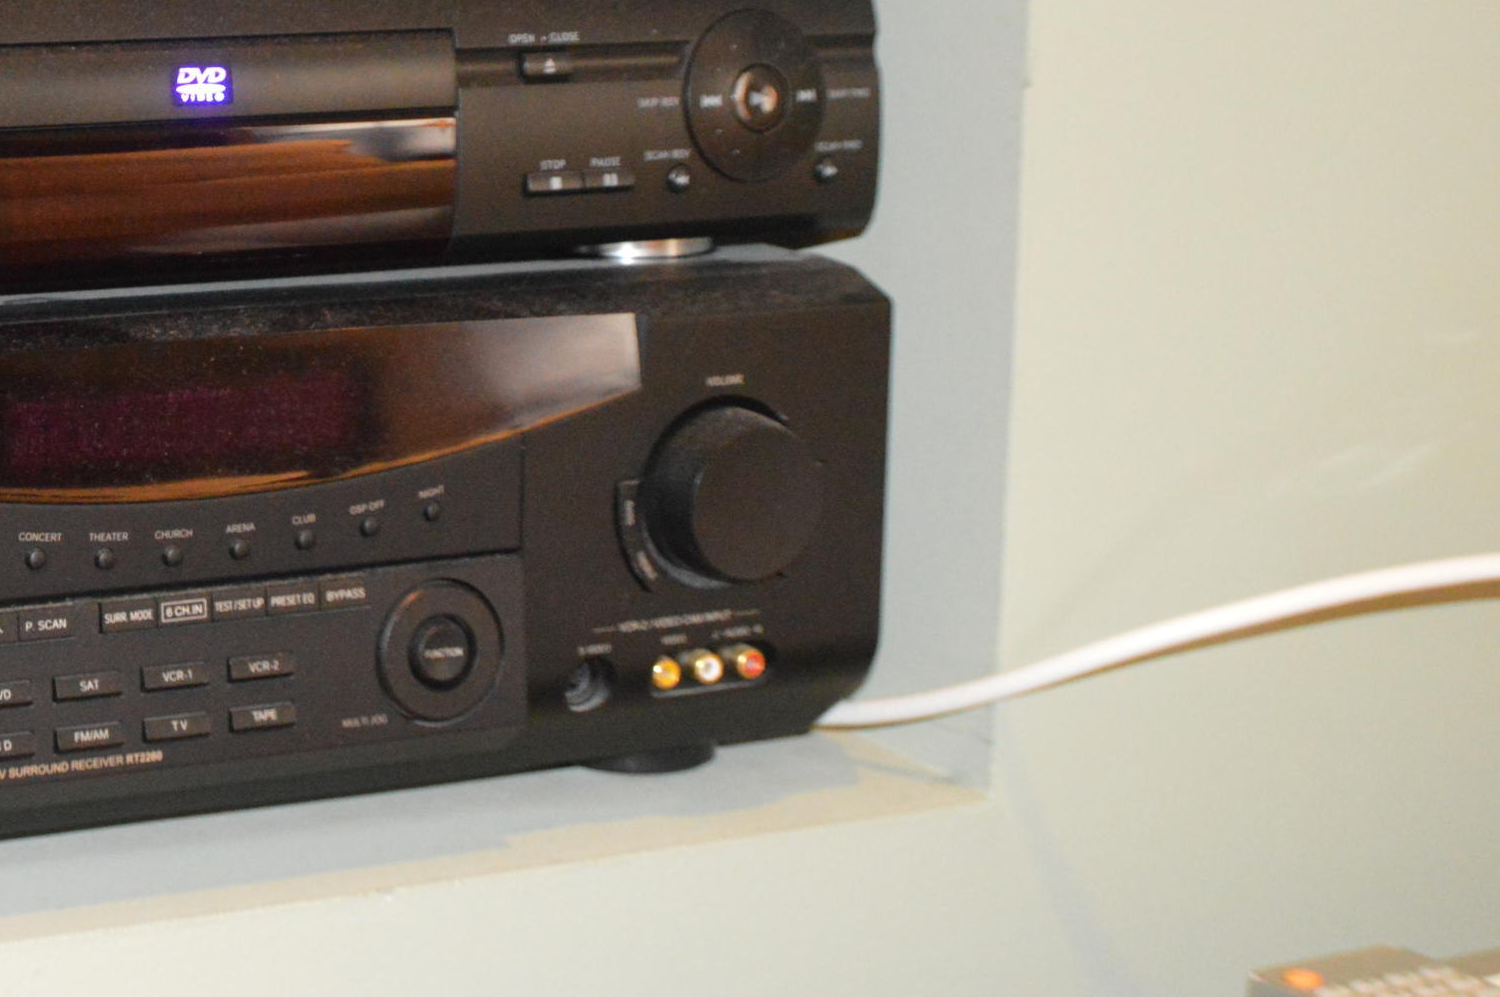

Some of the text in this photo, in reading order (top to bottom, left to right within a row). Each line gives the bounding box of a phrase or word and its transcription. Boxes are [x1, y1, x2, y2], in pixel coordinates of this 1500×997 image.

[176, 66, 227, 84] DVD
[291, 513, 317, 526] CLUB
[154, 529, 194, 541] CHURCH
[226, 522, 257, 535] ARENA
[18, 531, 63, 543] CONCERT
[88, 531, 130, 542] THEATER
[325, 587, 366, 602] BYPASS
[38, 618, 67, 631] SCAN
[248, 659, 280, 674] VCR-2
[162, 669, 194, 682] VCR-1
[79, 679, 100, 692] SAT
[251, 709, 277, 722] TAPE
[73, 729, 110, 743] FM/AM
[8, 761, 69, 780] SURROUND
[71, 755, 124, 771] RECEIVER
